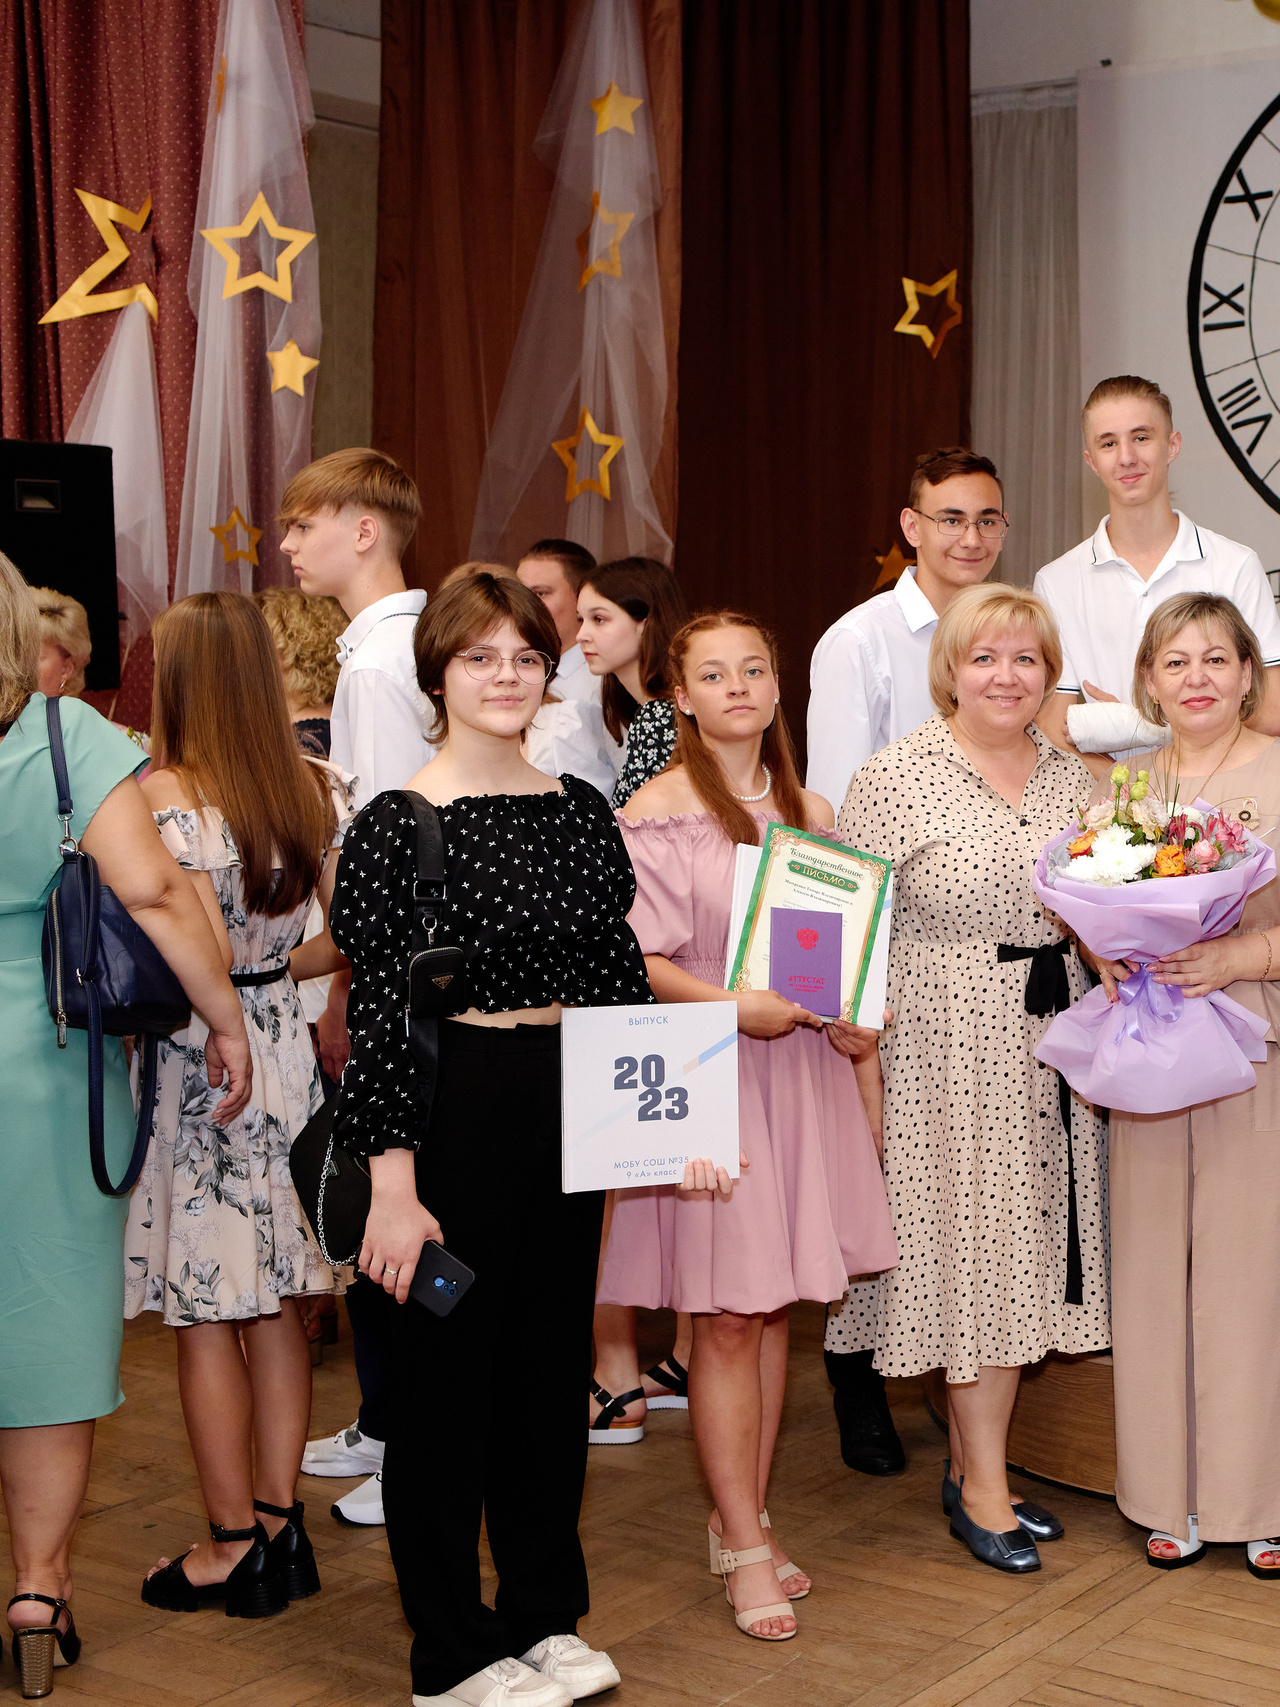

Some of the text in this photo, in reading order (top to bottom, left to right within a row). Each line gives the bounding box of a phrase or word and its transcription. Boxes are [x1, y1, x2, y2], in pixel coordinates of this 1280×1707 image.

[1224, 169, 1274, 222] X
[1202, 281, 1246, 333] IX
[1217, 378, 1274, 456] VIII
[790, 847, 864, 879] Благодарственное
[802, 866, 846, 887] ПИСЬМО
[788, 976, 825, 984] АТТЕСТАТ
[628, 1015, 669, 1026] ВЫПУСК
[613, 1053, 666, 1090] 20
[638, 1086, 689, 1122] 23
[614, 1155, 689, 1169] МОБУ СОШ №35
[654, 1168, 677, 1176] класс
